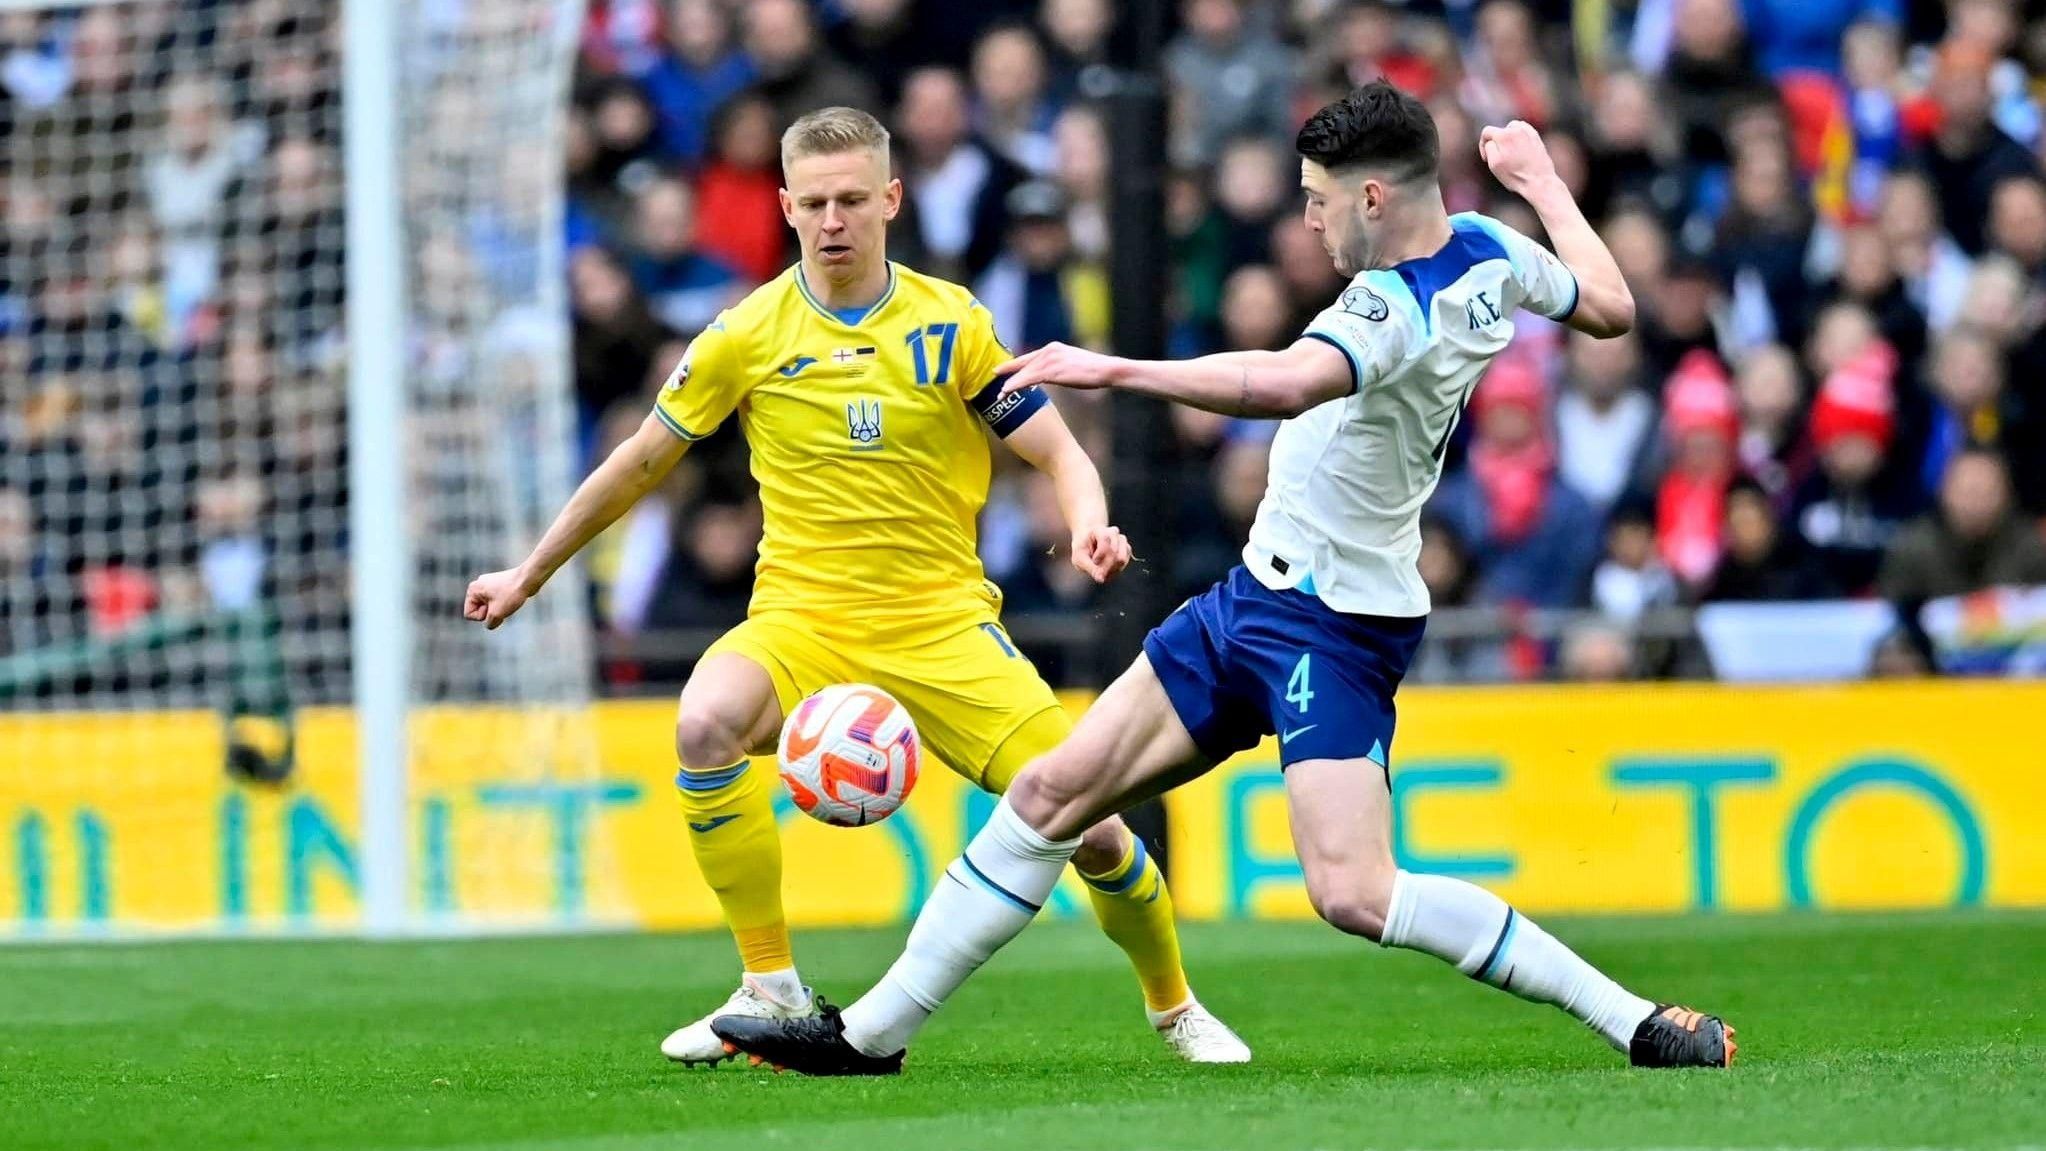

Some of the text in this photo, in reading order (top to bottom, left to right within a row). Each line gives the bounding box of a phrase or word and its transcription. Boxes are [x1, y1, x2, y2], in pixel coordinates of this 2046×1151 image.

[905, 322, 958, 386] 17
[1285, 652, 1315, 713] 4
[1611, 756, 1987, 910] TO
